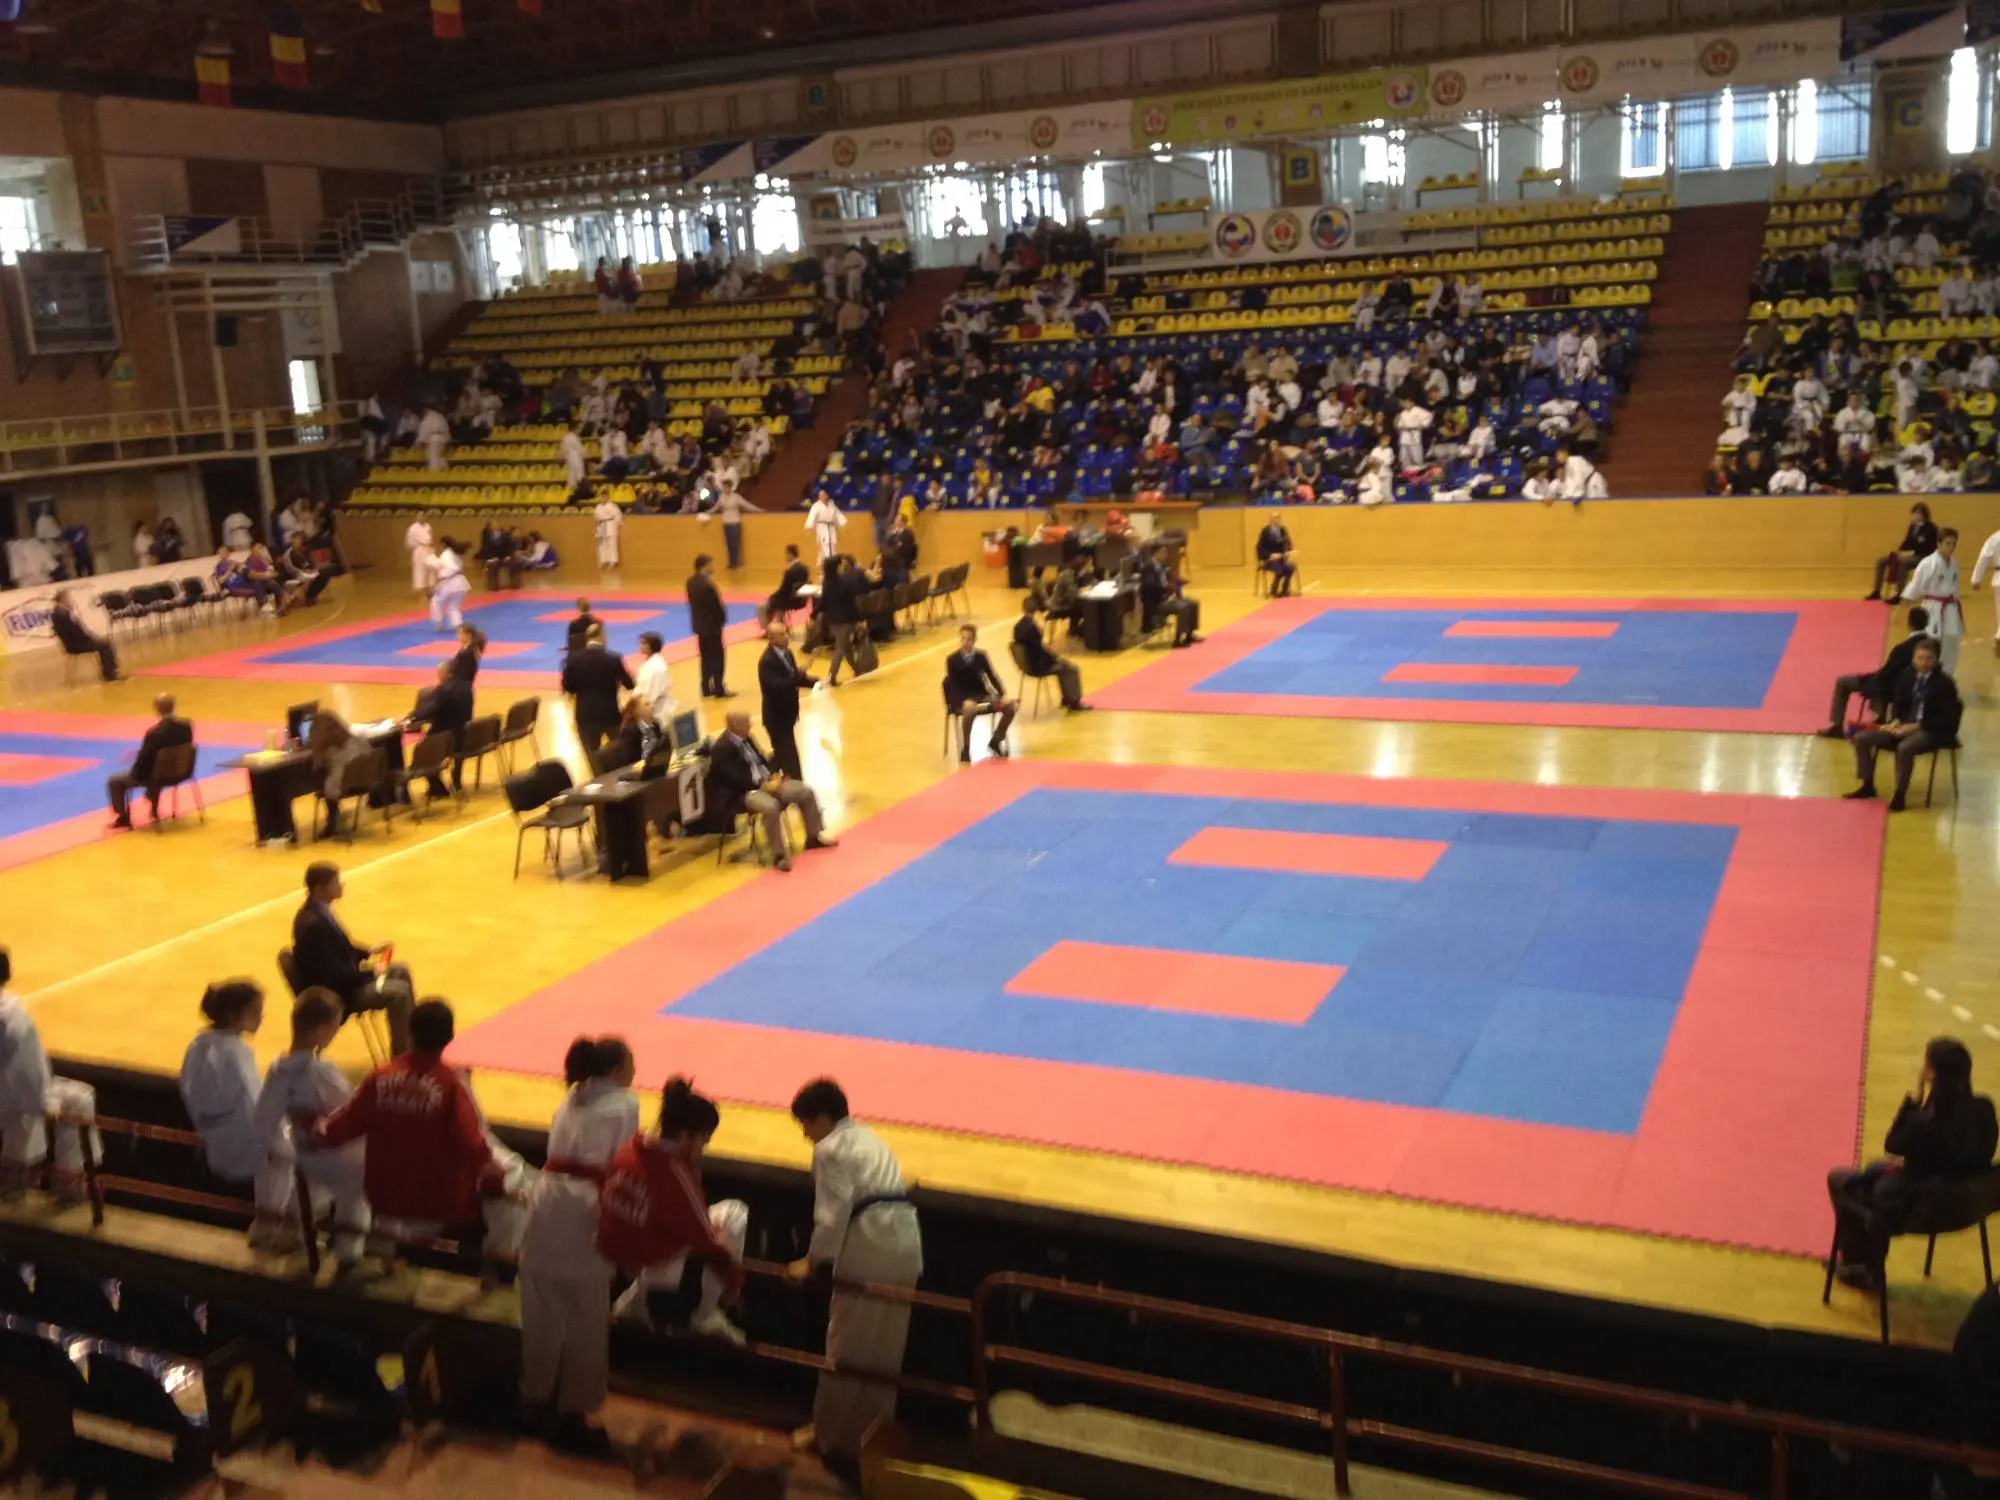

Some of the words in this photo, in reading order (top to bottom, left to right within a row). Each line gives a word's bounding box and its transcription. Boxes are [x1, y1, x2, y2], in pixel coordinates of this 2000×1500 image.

[1899, 101, 1922, 127] C
[1291, 158, 1309, 180] B
[222, 1366, 262, 1437] 2
